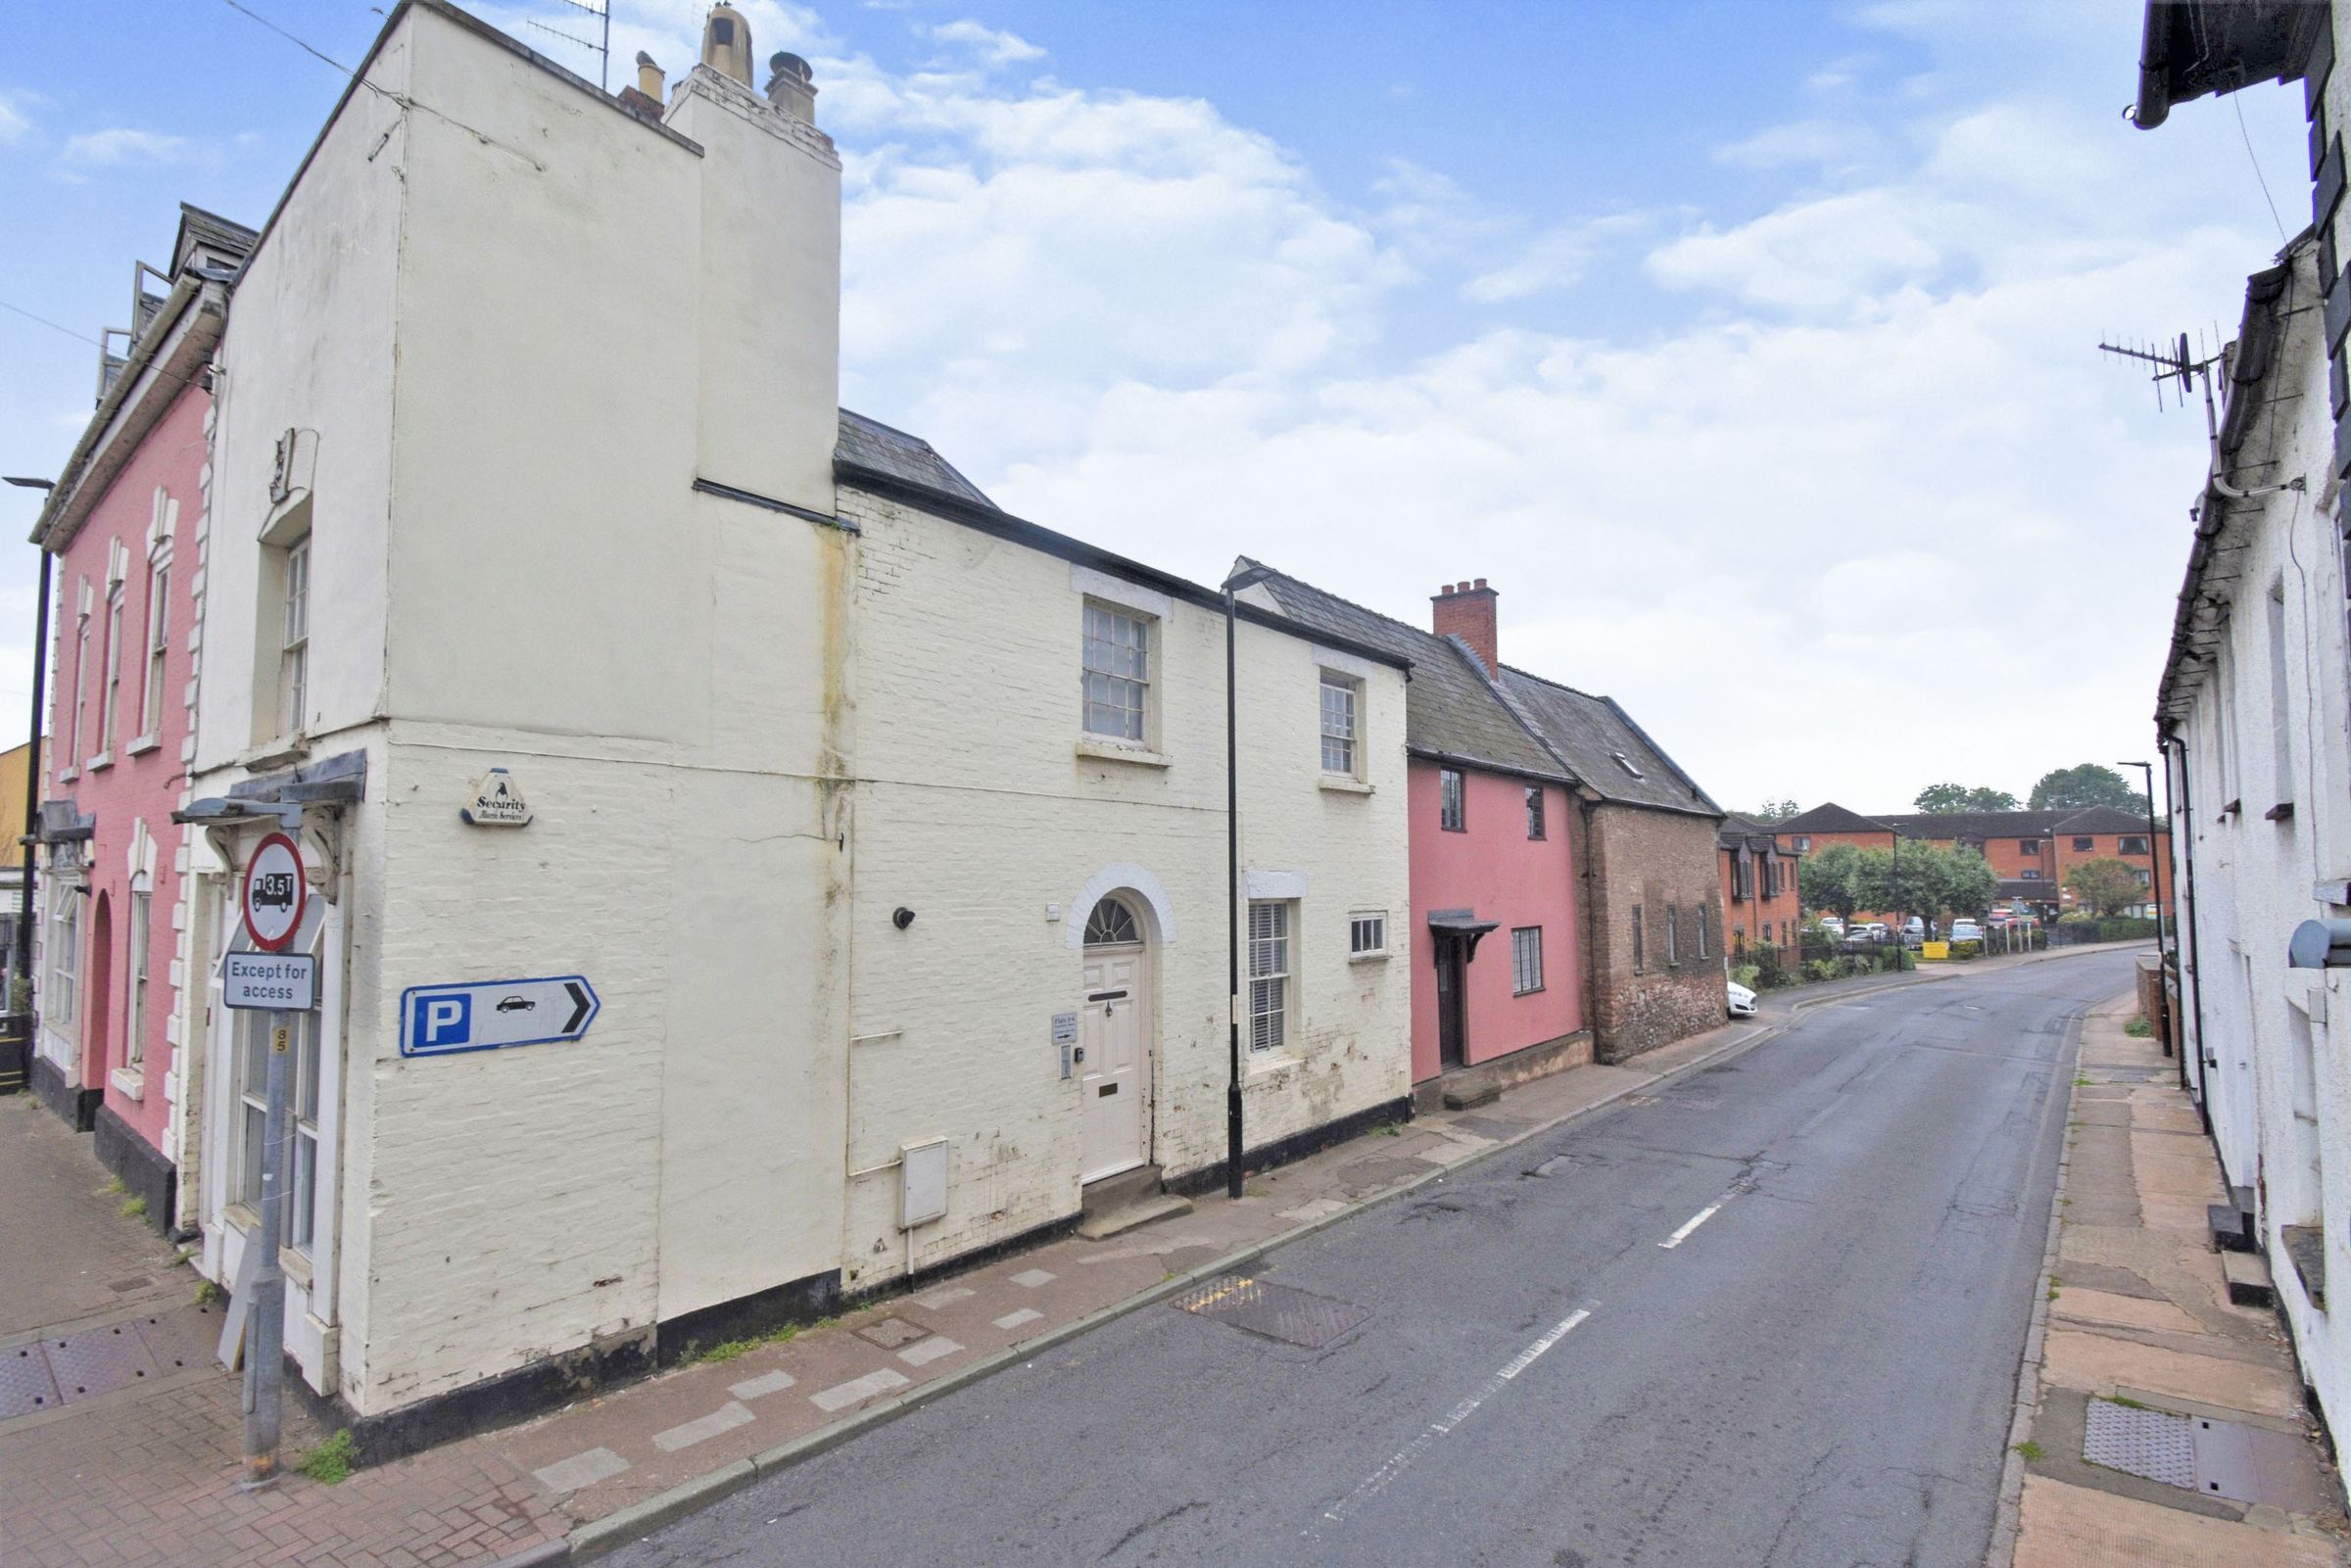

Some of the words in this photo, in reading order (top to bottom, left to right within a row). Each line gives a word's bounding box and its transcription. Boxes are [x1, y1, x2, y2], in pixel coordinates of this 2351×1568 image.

[477, 796, 525, 812] Security
[232, 962, 281, 980] Except
[285, 964, 307, 979] for
[243, 985, 293, 999] access
[426, 999, 462, 1043] P
